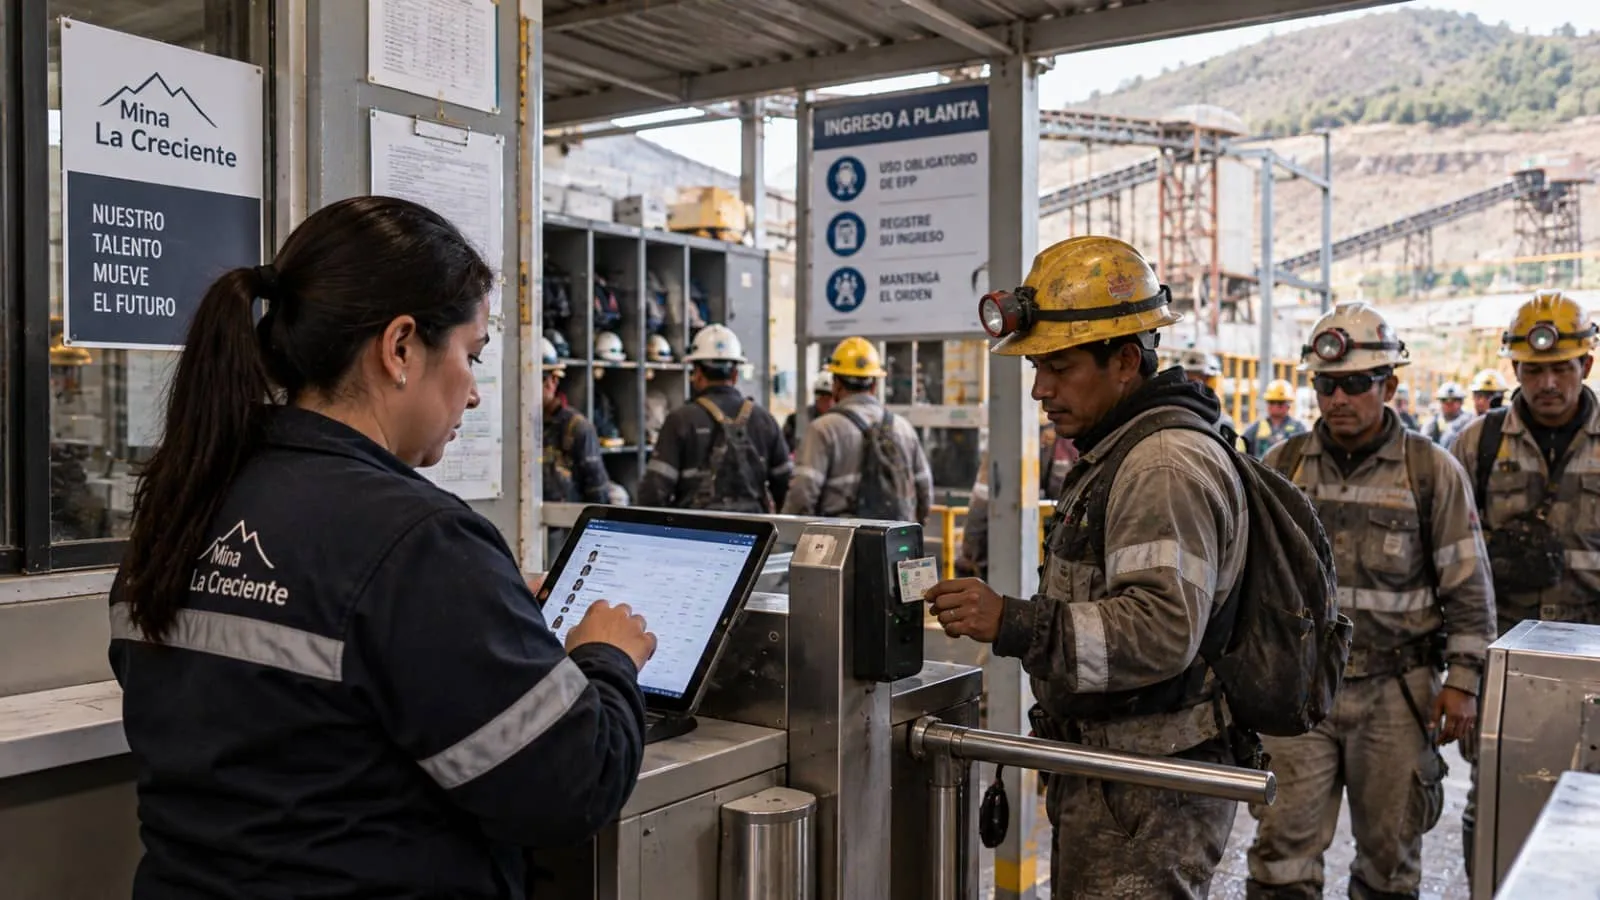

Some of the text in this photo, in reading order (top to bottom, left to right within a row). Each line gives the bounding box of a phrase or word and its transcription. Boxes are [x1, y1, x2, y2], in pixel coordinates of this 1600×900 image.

[120, 99, 169, 129] Mina
[824, 100, 981, 137] INGRESO A PLANTA
[95, 121, 237, 168] La Creciente
[879, 152, 979, 174] USO OBLIGATORIO
[879, 175, 918, 190] DE EPP
[92, 203, 165, 231] NUESTRO
[879, 214, 932, 230] REGISTRE
[92, 233, 163, 259] TALENTO
[879, 230, 945, 246] SU INGRESO
[93, 262, 150, 287] MUEVE
[879, 272, 941, 286] MANTENGA
[93, 292, 176, 317] EL FUTURO
[879, 288, 933, 302] EL ORDEN
[210, 544, 241, 568] Mina
[190, 568, 289, 606] La Creciente
